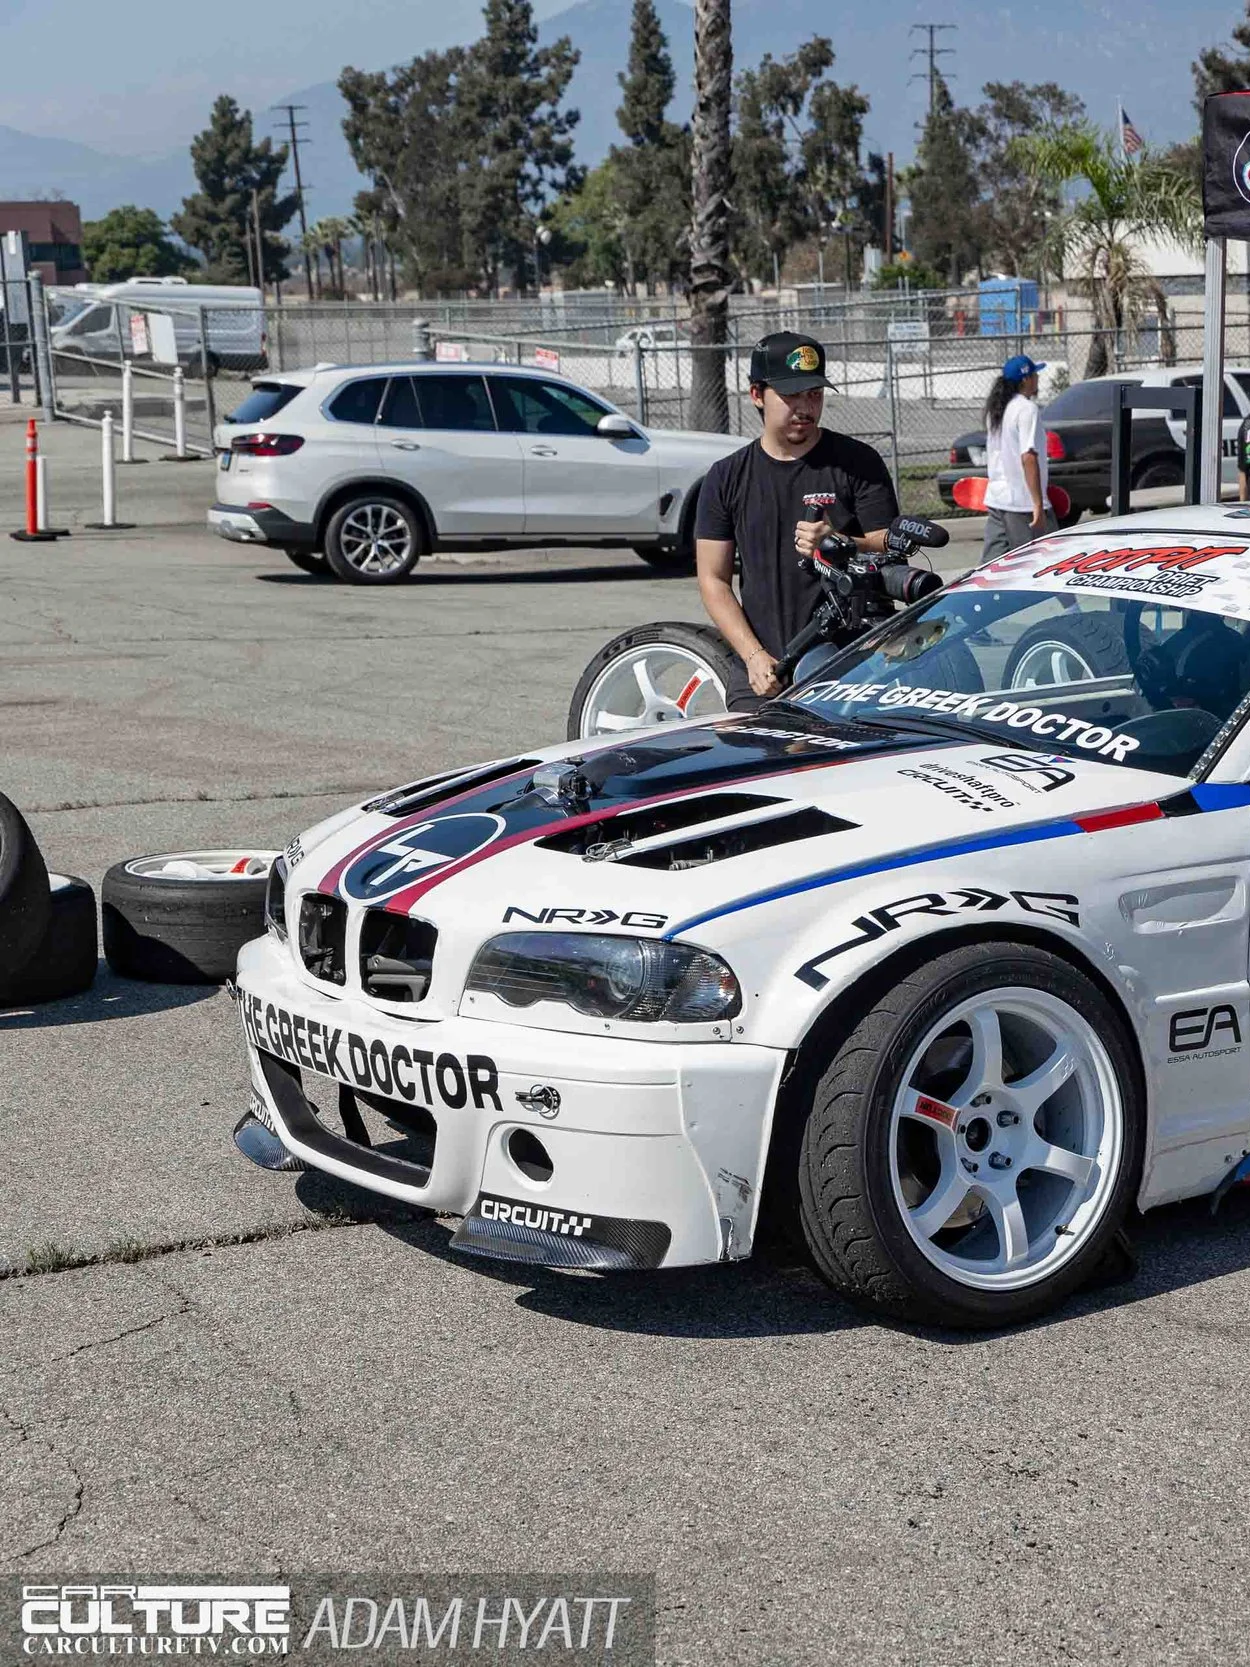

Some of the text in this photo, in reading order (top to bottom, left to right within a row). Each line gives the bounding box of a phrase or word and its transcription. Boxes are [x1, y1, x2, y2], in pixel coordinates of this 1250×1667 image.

[900, 519, 932, 538] RØDE
[1033, 546, 1249, 578] HOTPIT
[1066, 574, 1204, 597] CHAMPIONSHIP
[1155, 570, 1219, 588] DRIFT
[830, 683, 1141, 762] THE GREEK DOCTOR
[897, 769, 974, 801] CIRCUIT
[919, 762, 1015, 808] driveshaftpro
[265, 1003, 350, 1082] GREEK
[348, 1032, 503, 1111] DOCTOR
[1192, 1047, 1242, 1060] AUTOSPORT
[481, 1200, 564, 1232] CIRCUIT
